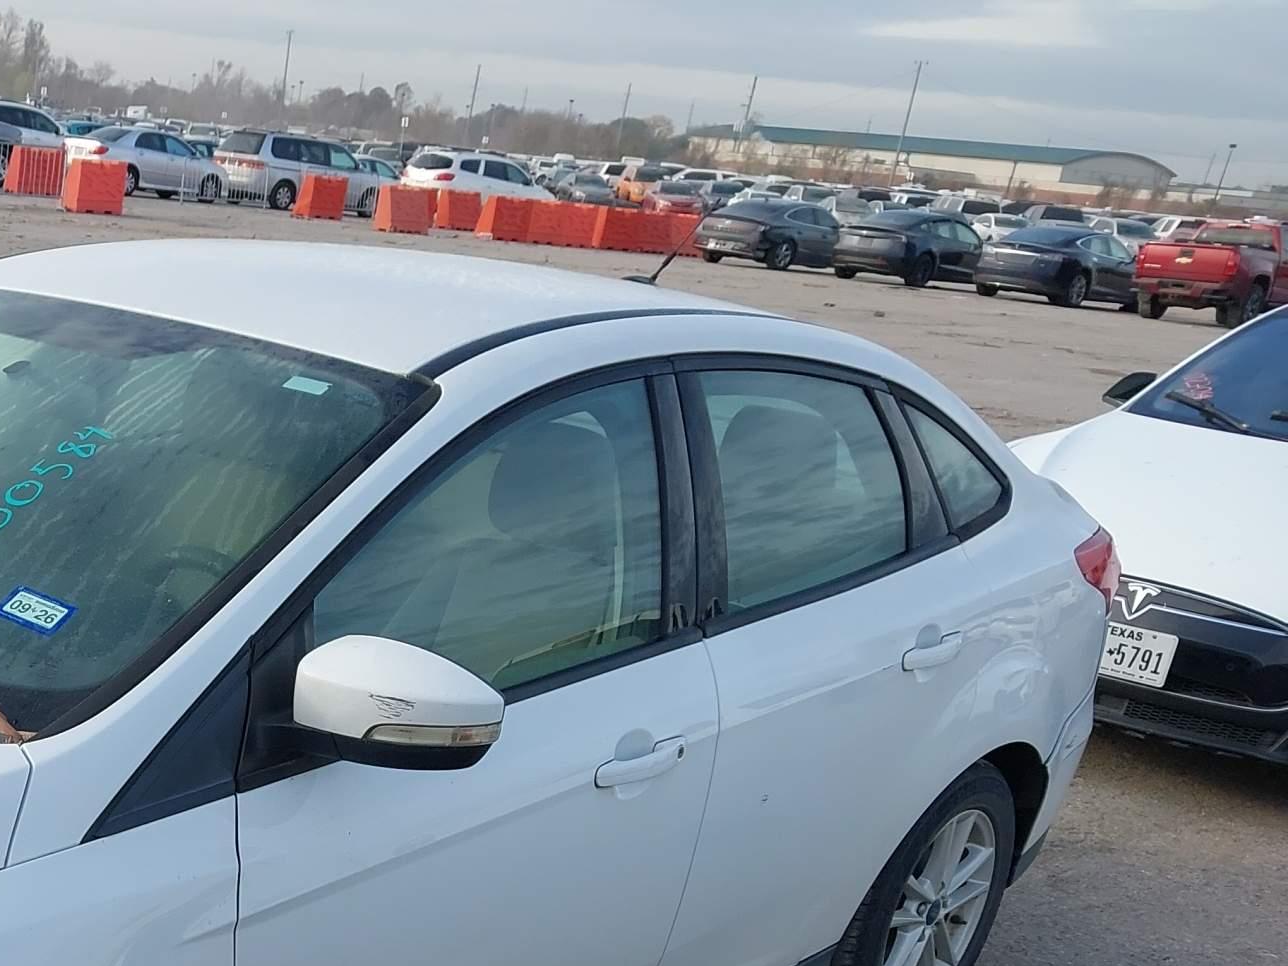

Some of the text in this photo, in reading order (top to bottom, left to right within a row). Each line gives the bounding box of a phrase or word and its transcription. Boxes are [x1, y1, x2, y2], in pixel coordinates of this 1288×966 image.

[9, 599, 33, 614] 09
[34, 608, 58, 624] 26
[1113, 642, 1164, 675] 5791
